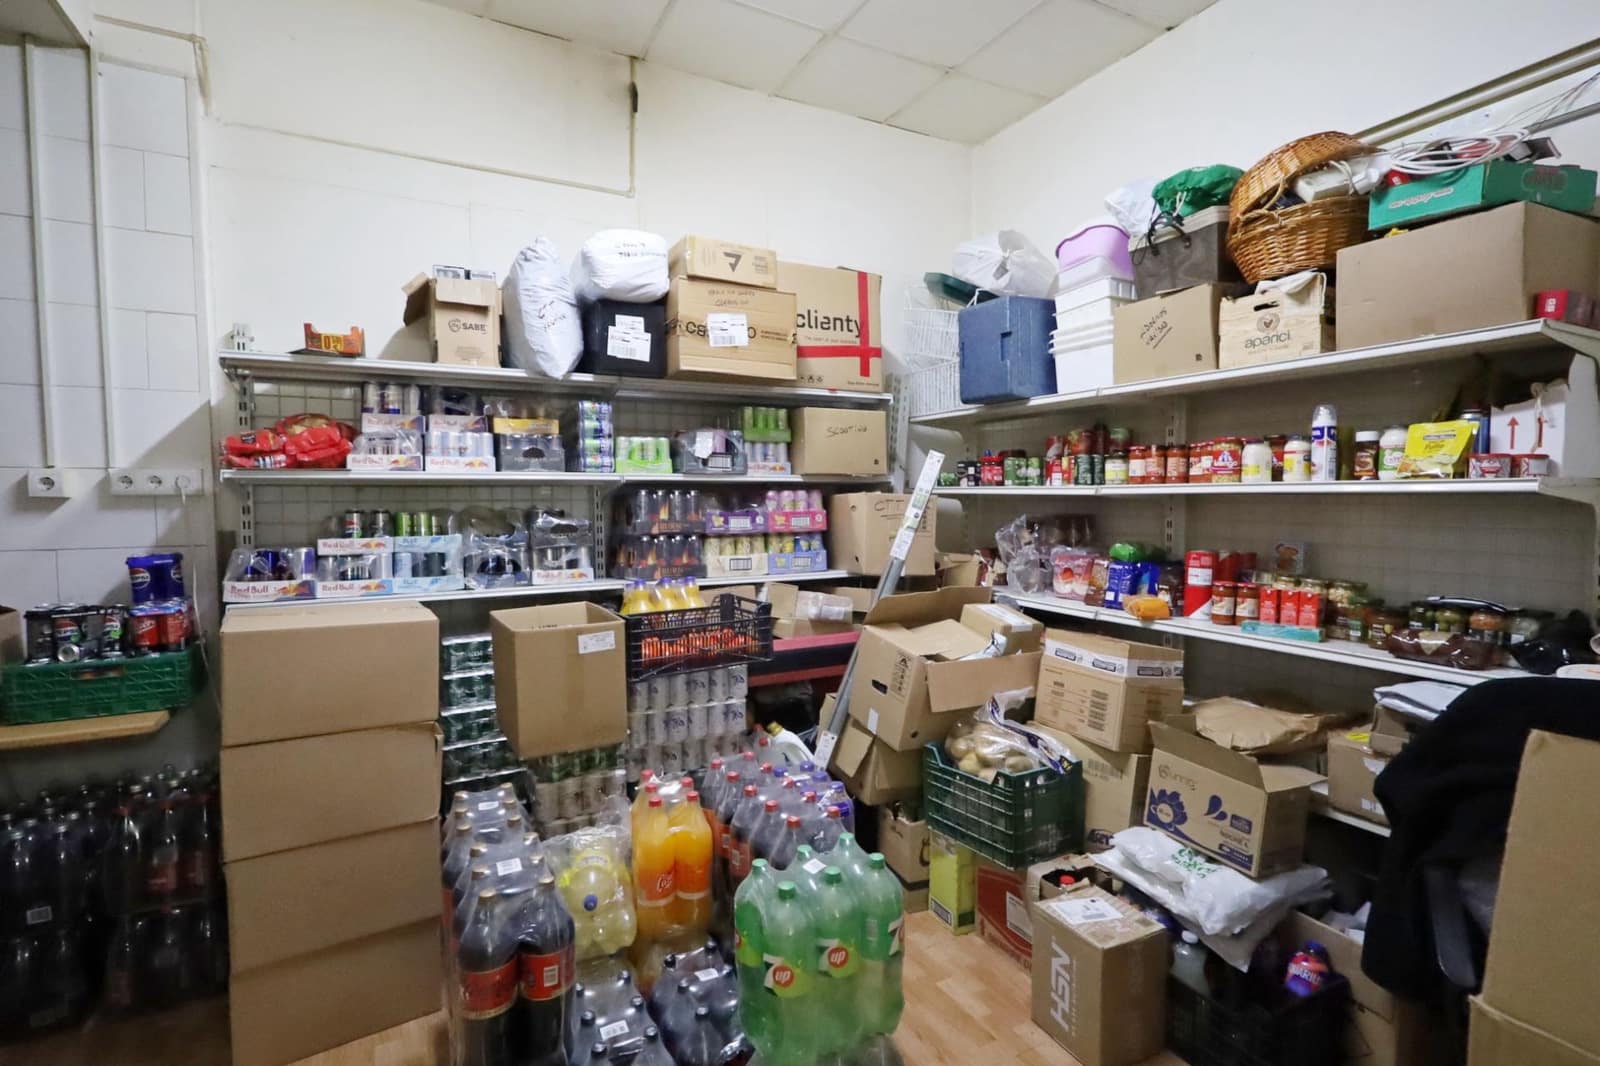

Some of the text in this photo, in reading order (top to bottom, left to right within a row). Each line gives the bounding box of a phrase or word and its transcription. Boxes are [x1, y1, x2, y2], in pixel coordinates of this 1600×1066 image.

[796, 309, 864, 338] clianty
[229, 584, 269, 595] Red Bull
[321, 582, 354, 592] Red Bull
[1049, 936, 1072, 1032] HSN
